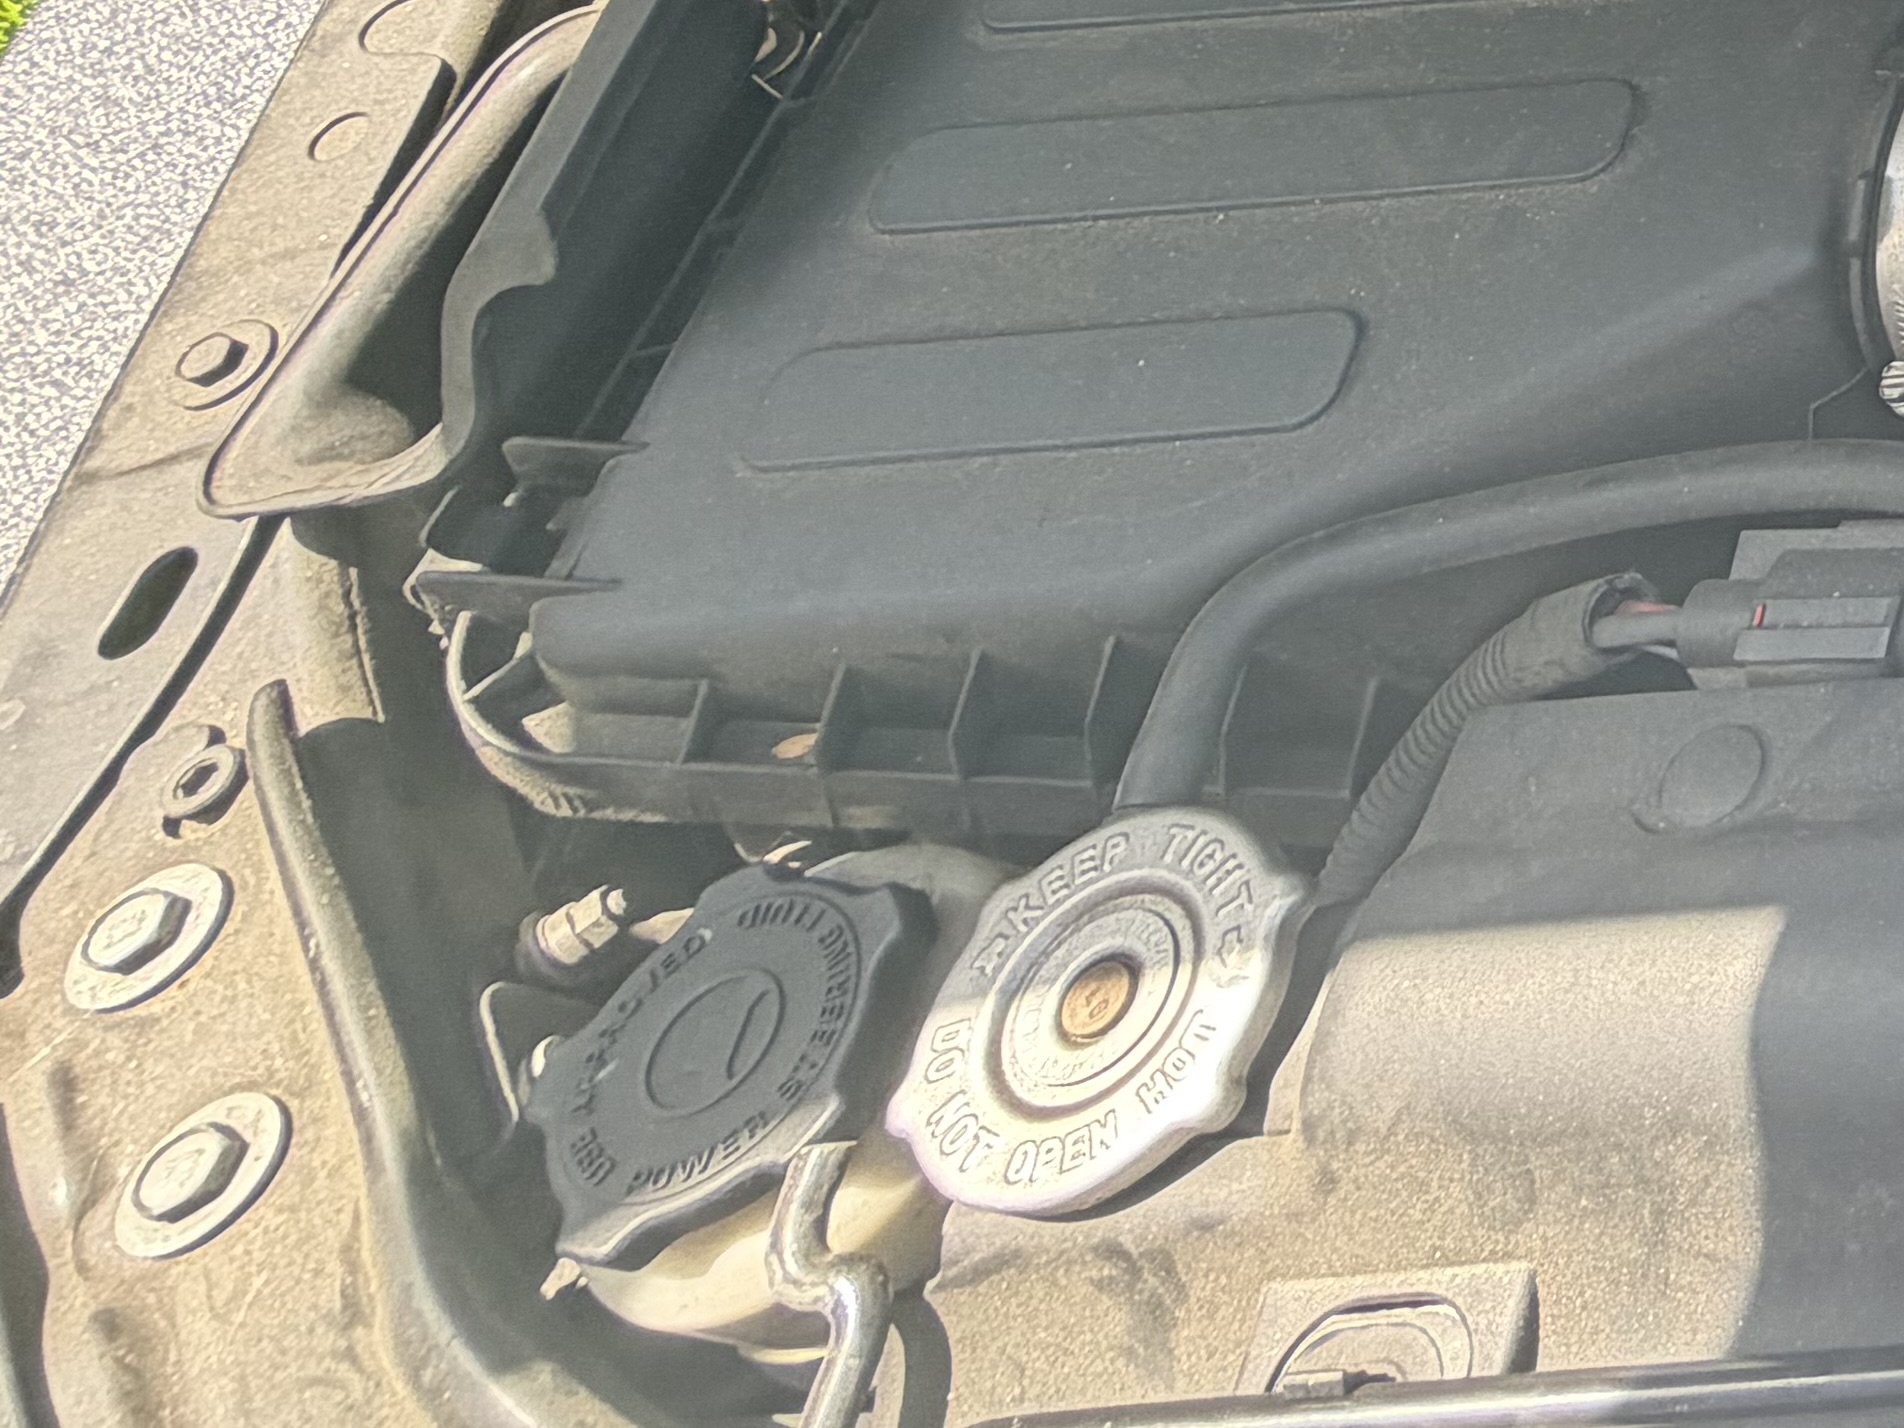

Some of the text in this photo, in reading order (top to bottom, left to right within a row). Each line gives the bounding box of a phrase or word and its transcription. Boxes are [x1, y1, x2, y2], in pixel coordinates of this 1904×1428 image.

[735, 897, 827, 933] FLUID
[1004, 822, 1256, 935] KEEP TIGHT
[776, 923, 854, 1102] STEERING
[626, 1111, 769, 1196] POWER
[925, 1009, 1218, 1186] DO NOT OPEN HOT
